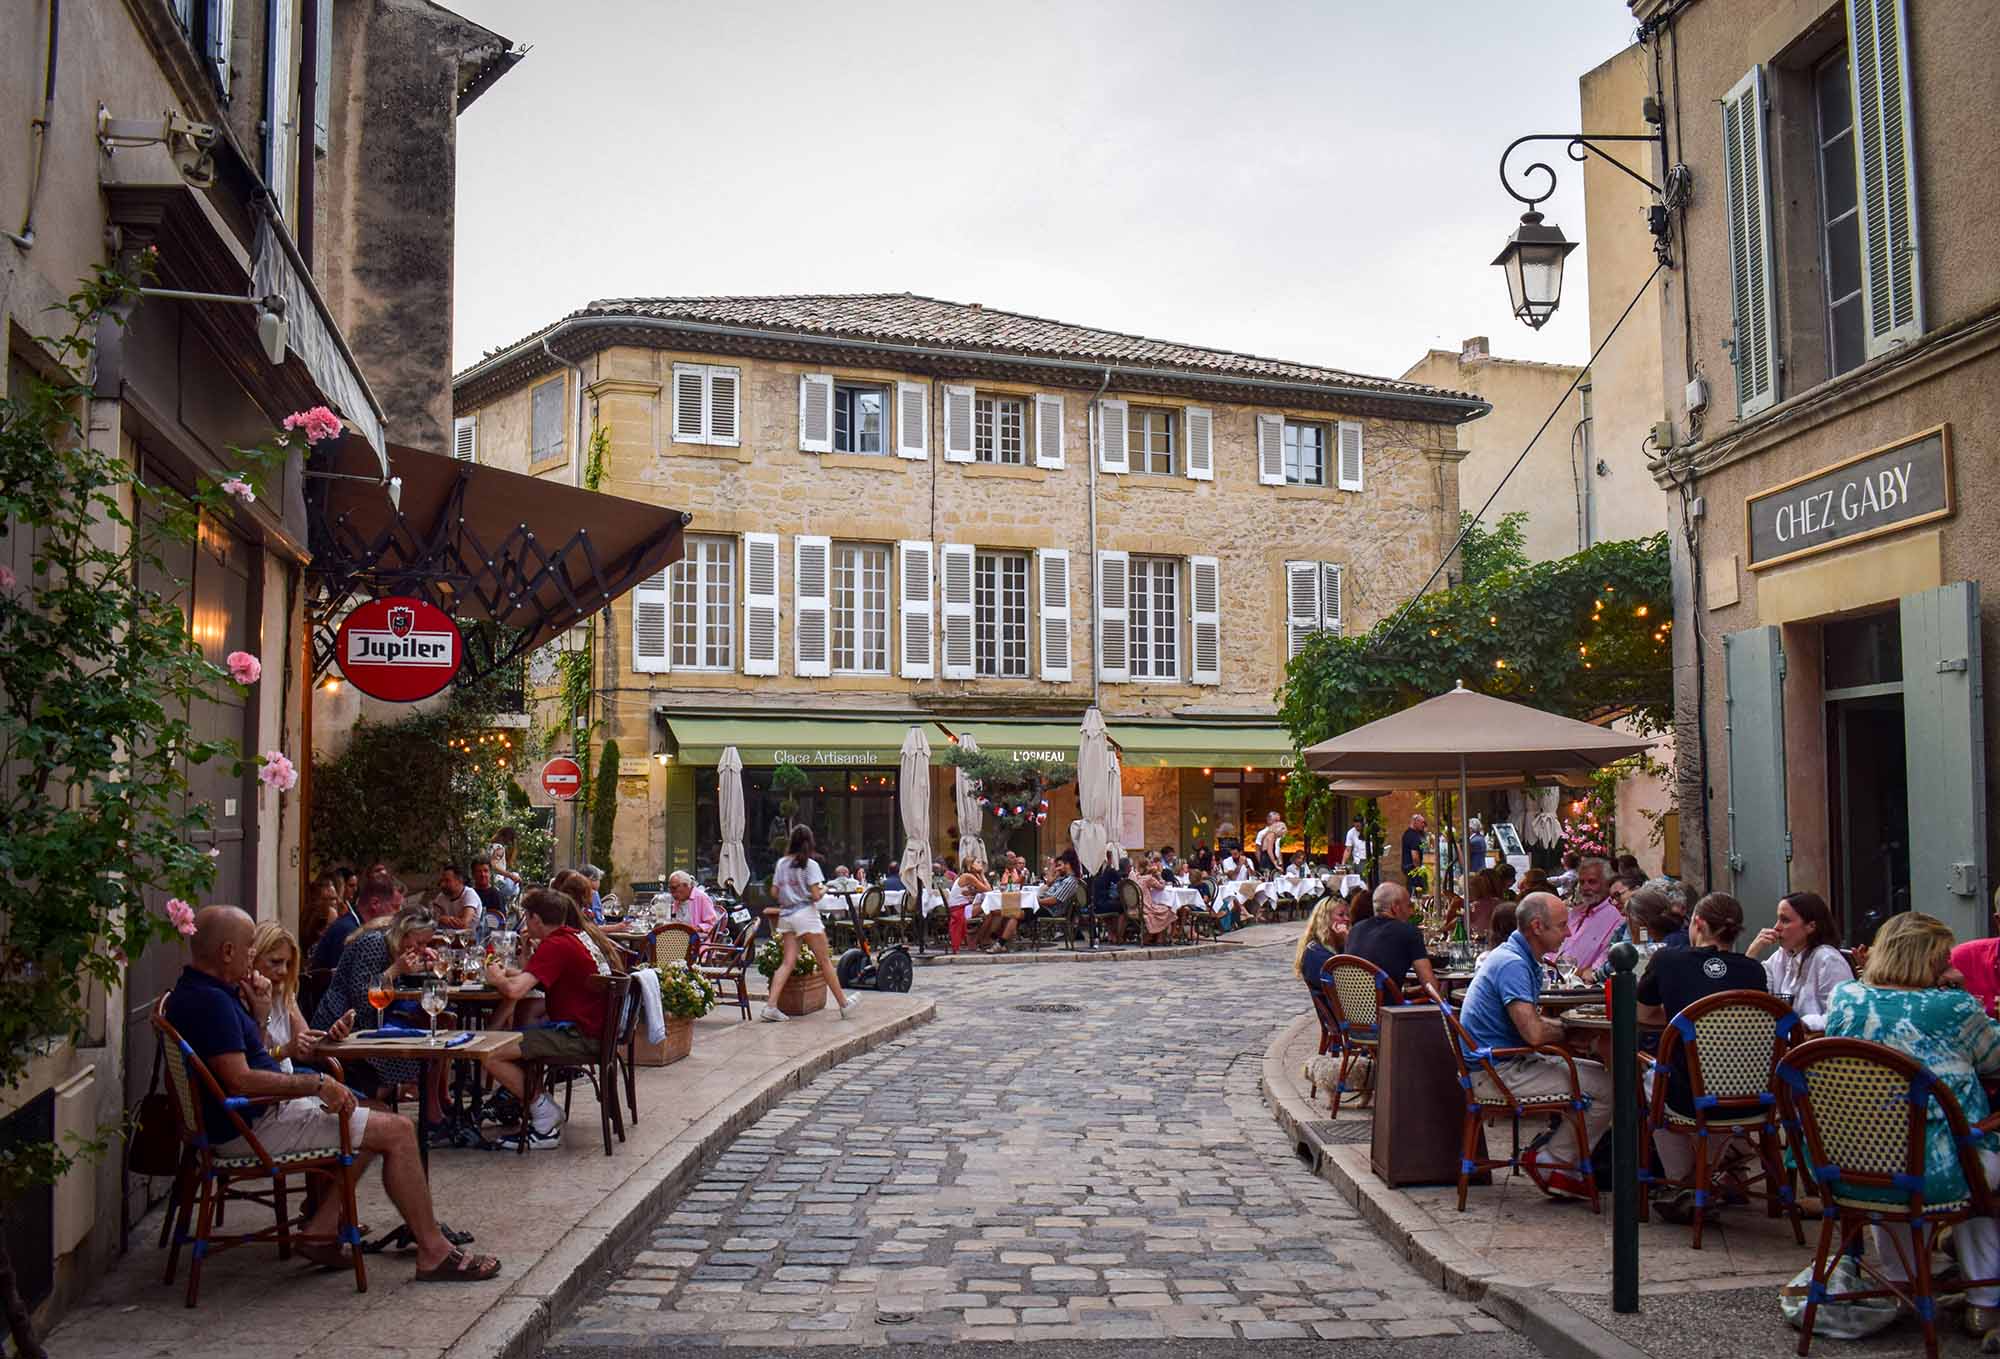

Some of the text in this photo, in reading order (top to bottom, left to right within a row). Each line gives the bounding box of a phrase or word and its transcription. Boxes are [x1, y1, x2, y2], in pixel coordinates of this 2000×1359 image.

[1775, 462, 1912, 542] CHEZ GABY
[356, 636, 446, 661] Jupiler
[814, 750, 878, 764] Artisanale
